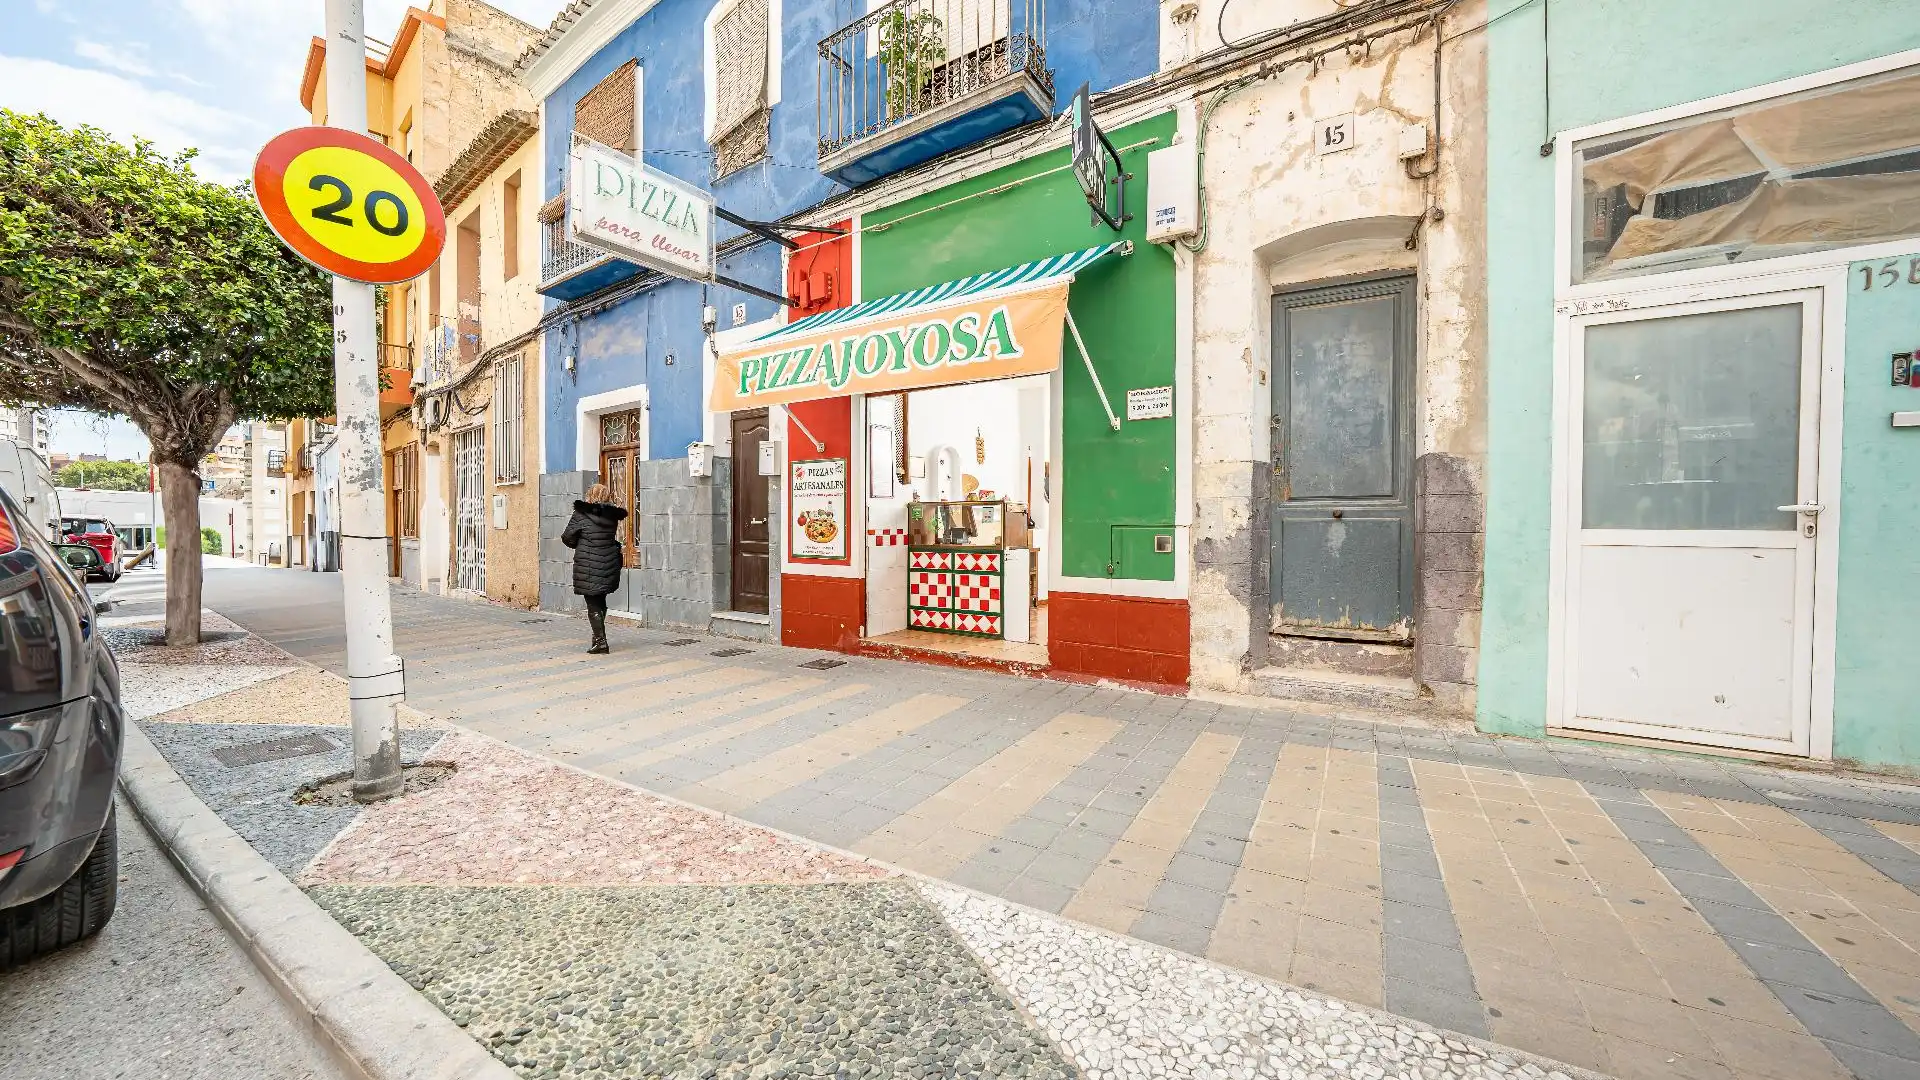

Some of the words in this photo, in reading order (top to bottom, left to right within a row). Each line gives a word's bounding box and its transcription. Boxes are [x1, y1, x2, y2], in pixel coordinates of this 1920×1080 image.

[1324, 122, 1345, 147] 15
[308, 174, 409, 237] 20
[593, 160, 699, 234] PIZZA
[594, 216, 642, 242] para
[651, 234, 700, 262] llevar
[738, 309, 1019, 395] PIZZAJOYOSA
[793, 480, 844, 491] ARTESANALES
[808, 467, 834, 477] PIZZAS
